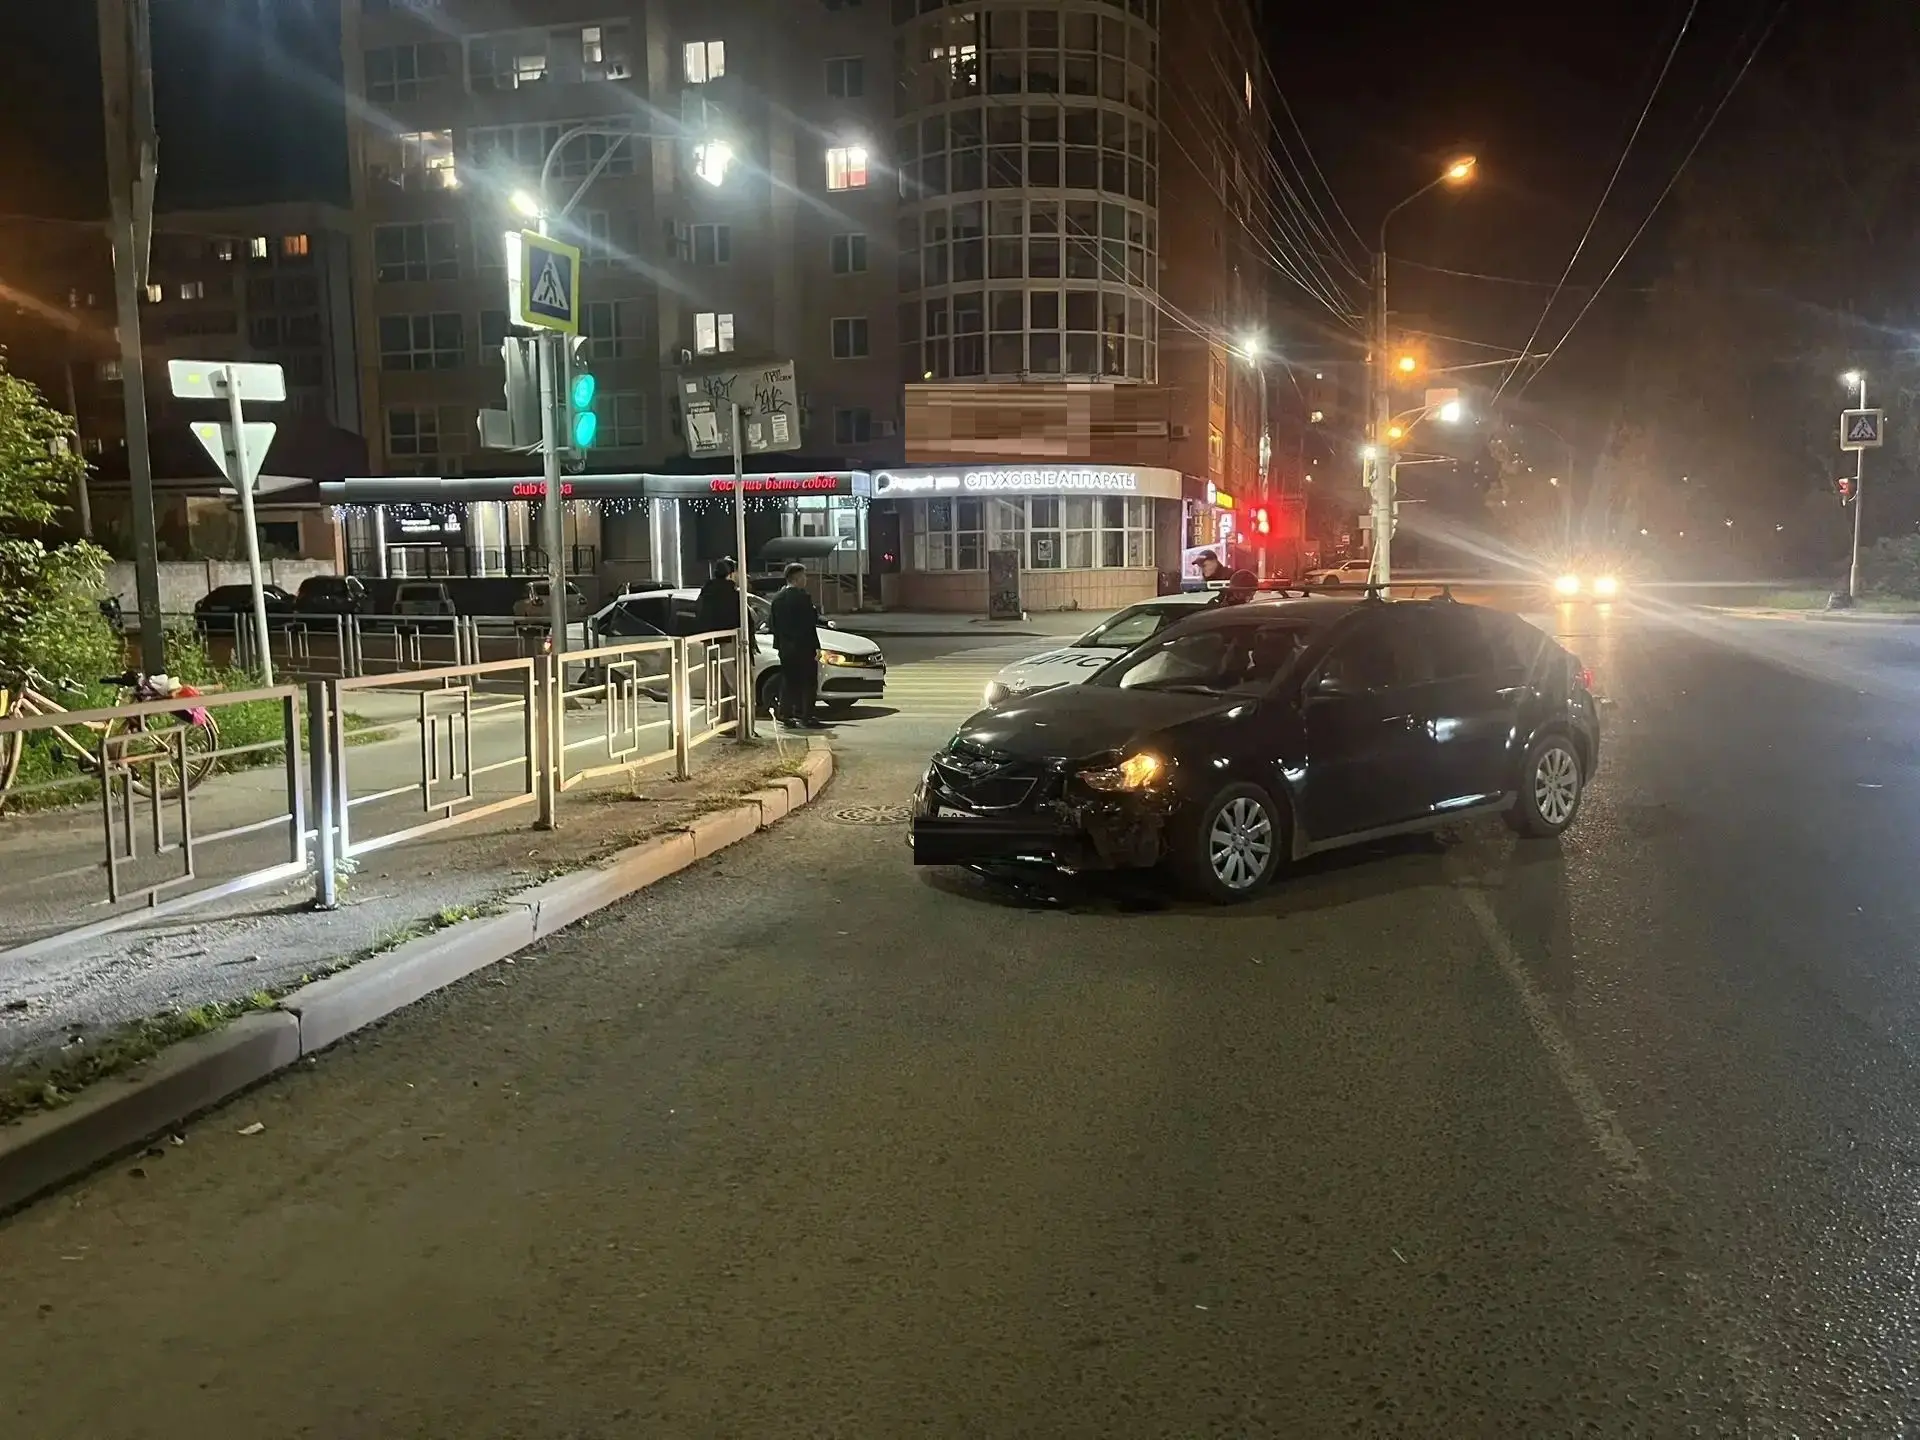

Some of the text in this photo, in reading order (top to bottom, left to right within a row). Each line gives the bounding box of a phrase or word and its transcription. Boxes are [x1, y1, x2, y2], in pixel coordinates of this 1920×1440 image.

[765, 476, 799, 490] быть
[801, 475, 837, 489] собой
[965, 472, 1056, 490] СЛУХОВЫЕ
[1056, 472, 1137, 490] АППАРАТЫ
[512, 483, 538, 495] club
